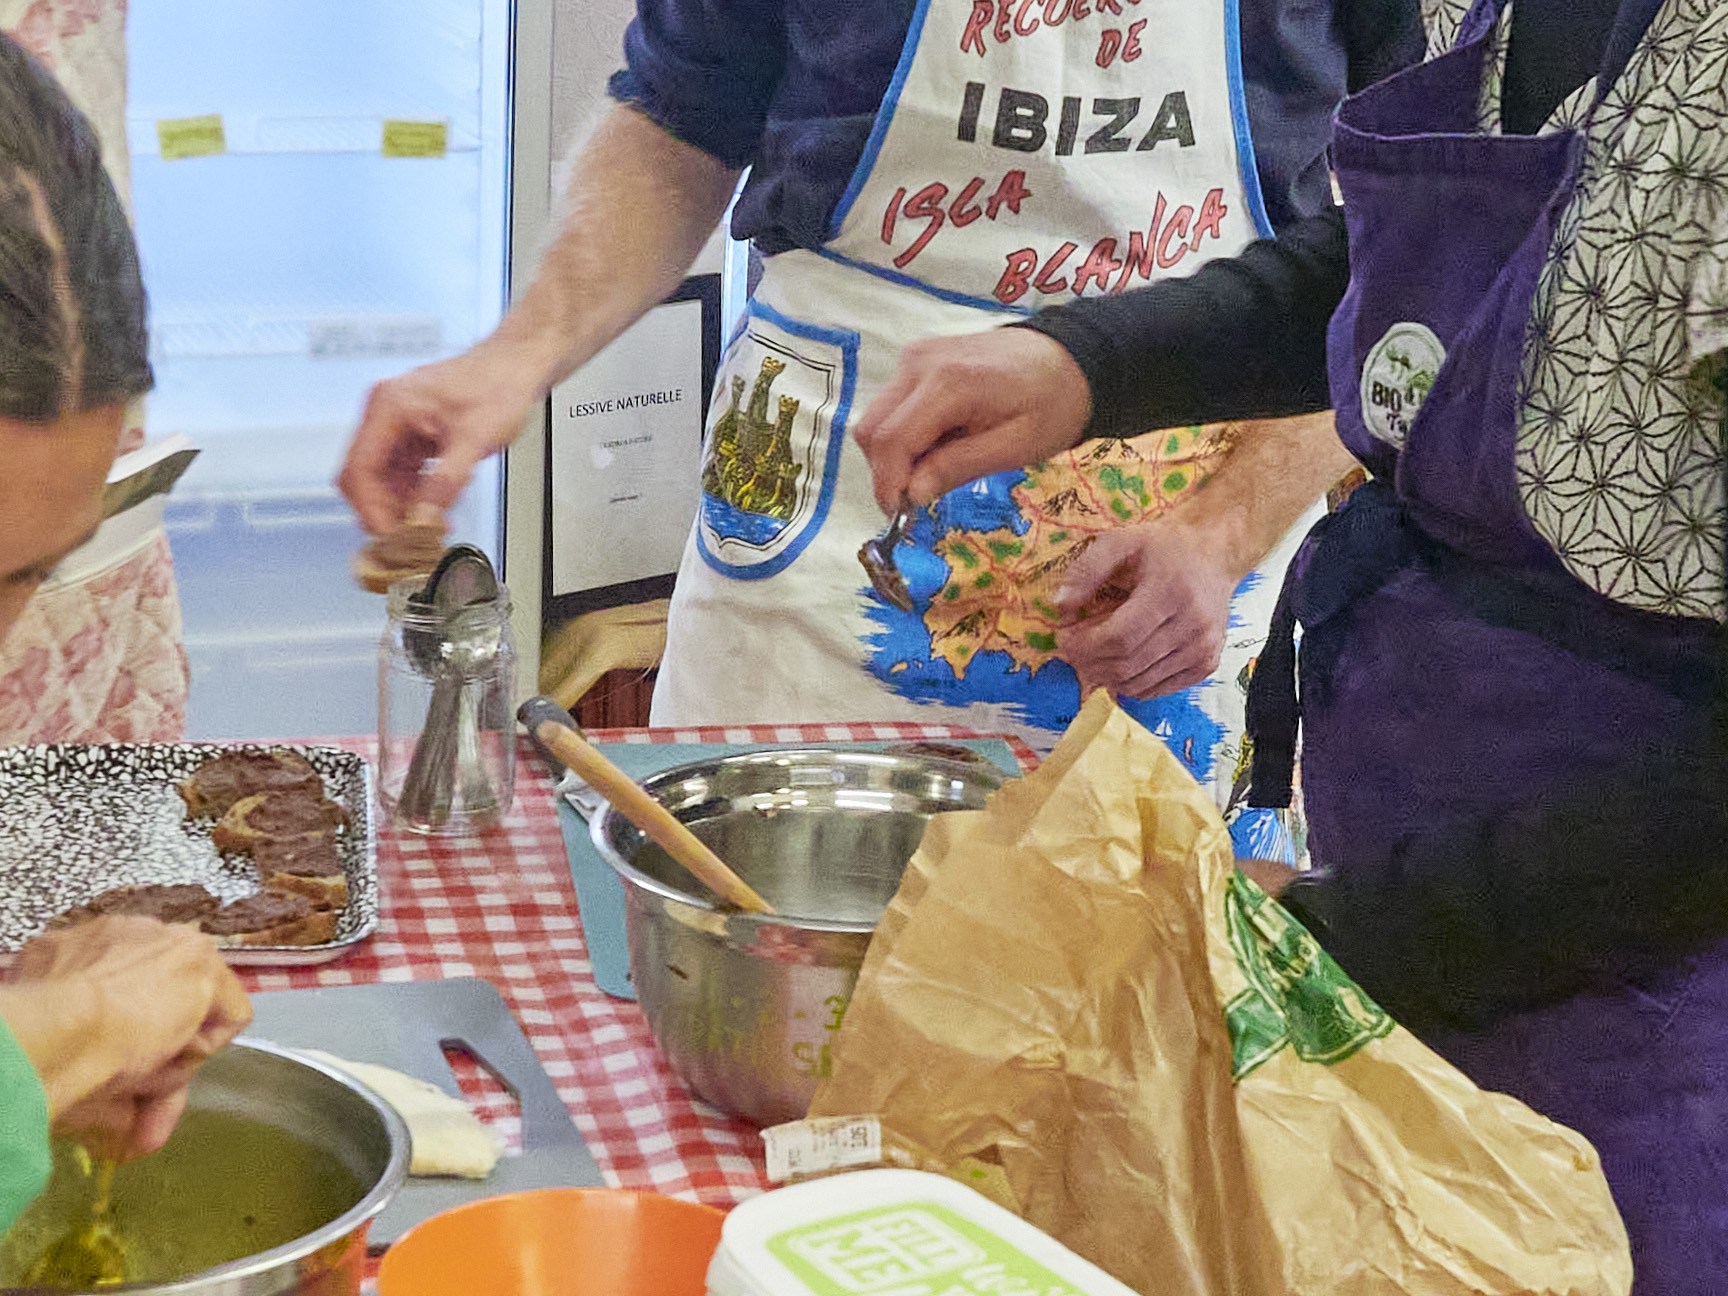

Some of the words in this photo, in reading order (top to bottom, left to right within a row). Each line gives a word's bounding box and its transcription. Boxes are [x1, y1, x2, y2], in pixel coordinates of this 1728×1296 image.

[1095, 18, 1148, 69] DE
[957, 81, 1196, 156] IBIZA
[992, 190, 1228, 305] BLANCA
[569, 400, 613, 418] LESSIVE
[616, 389, 682, 410] NATURELLE
[1372, 381, 1402, 412] BIO
[810, 1227, 912, 1286] ME
[874, 1217, 964, 1268] FILL
